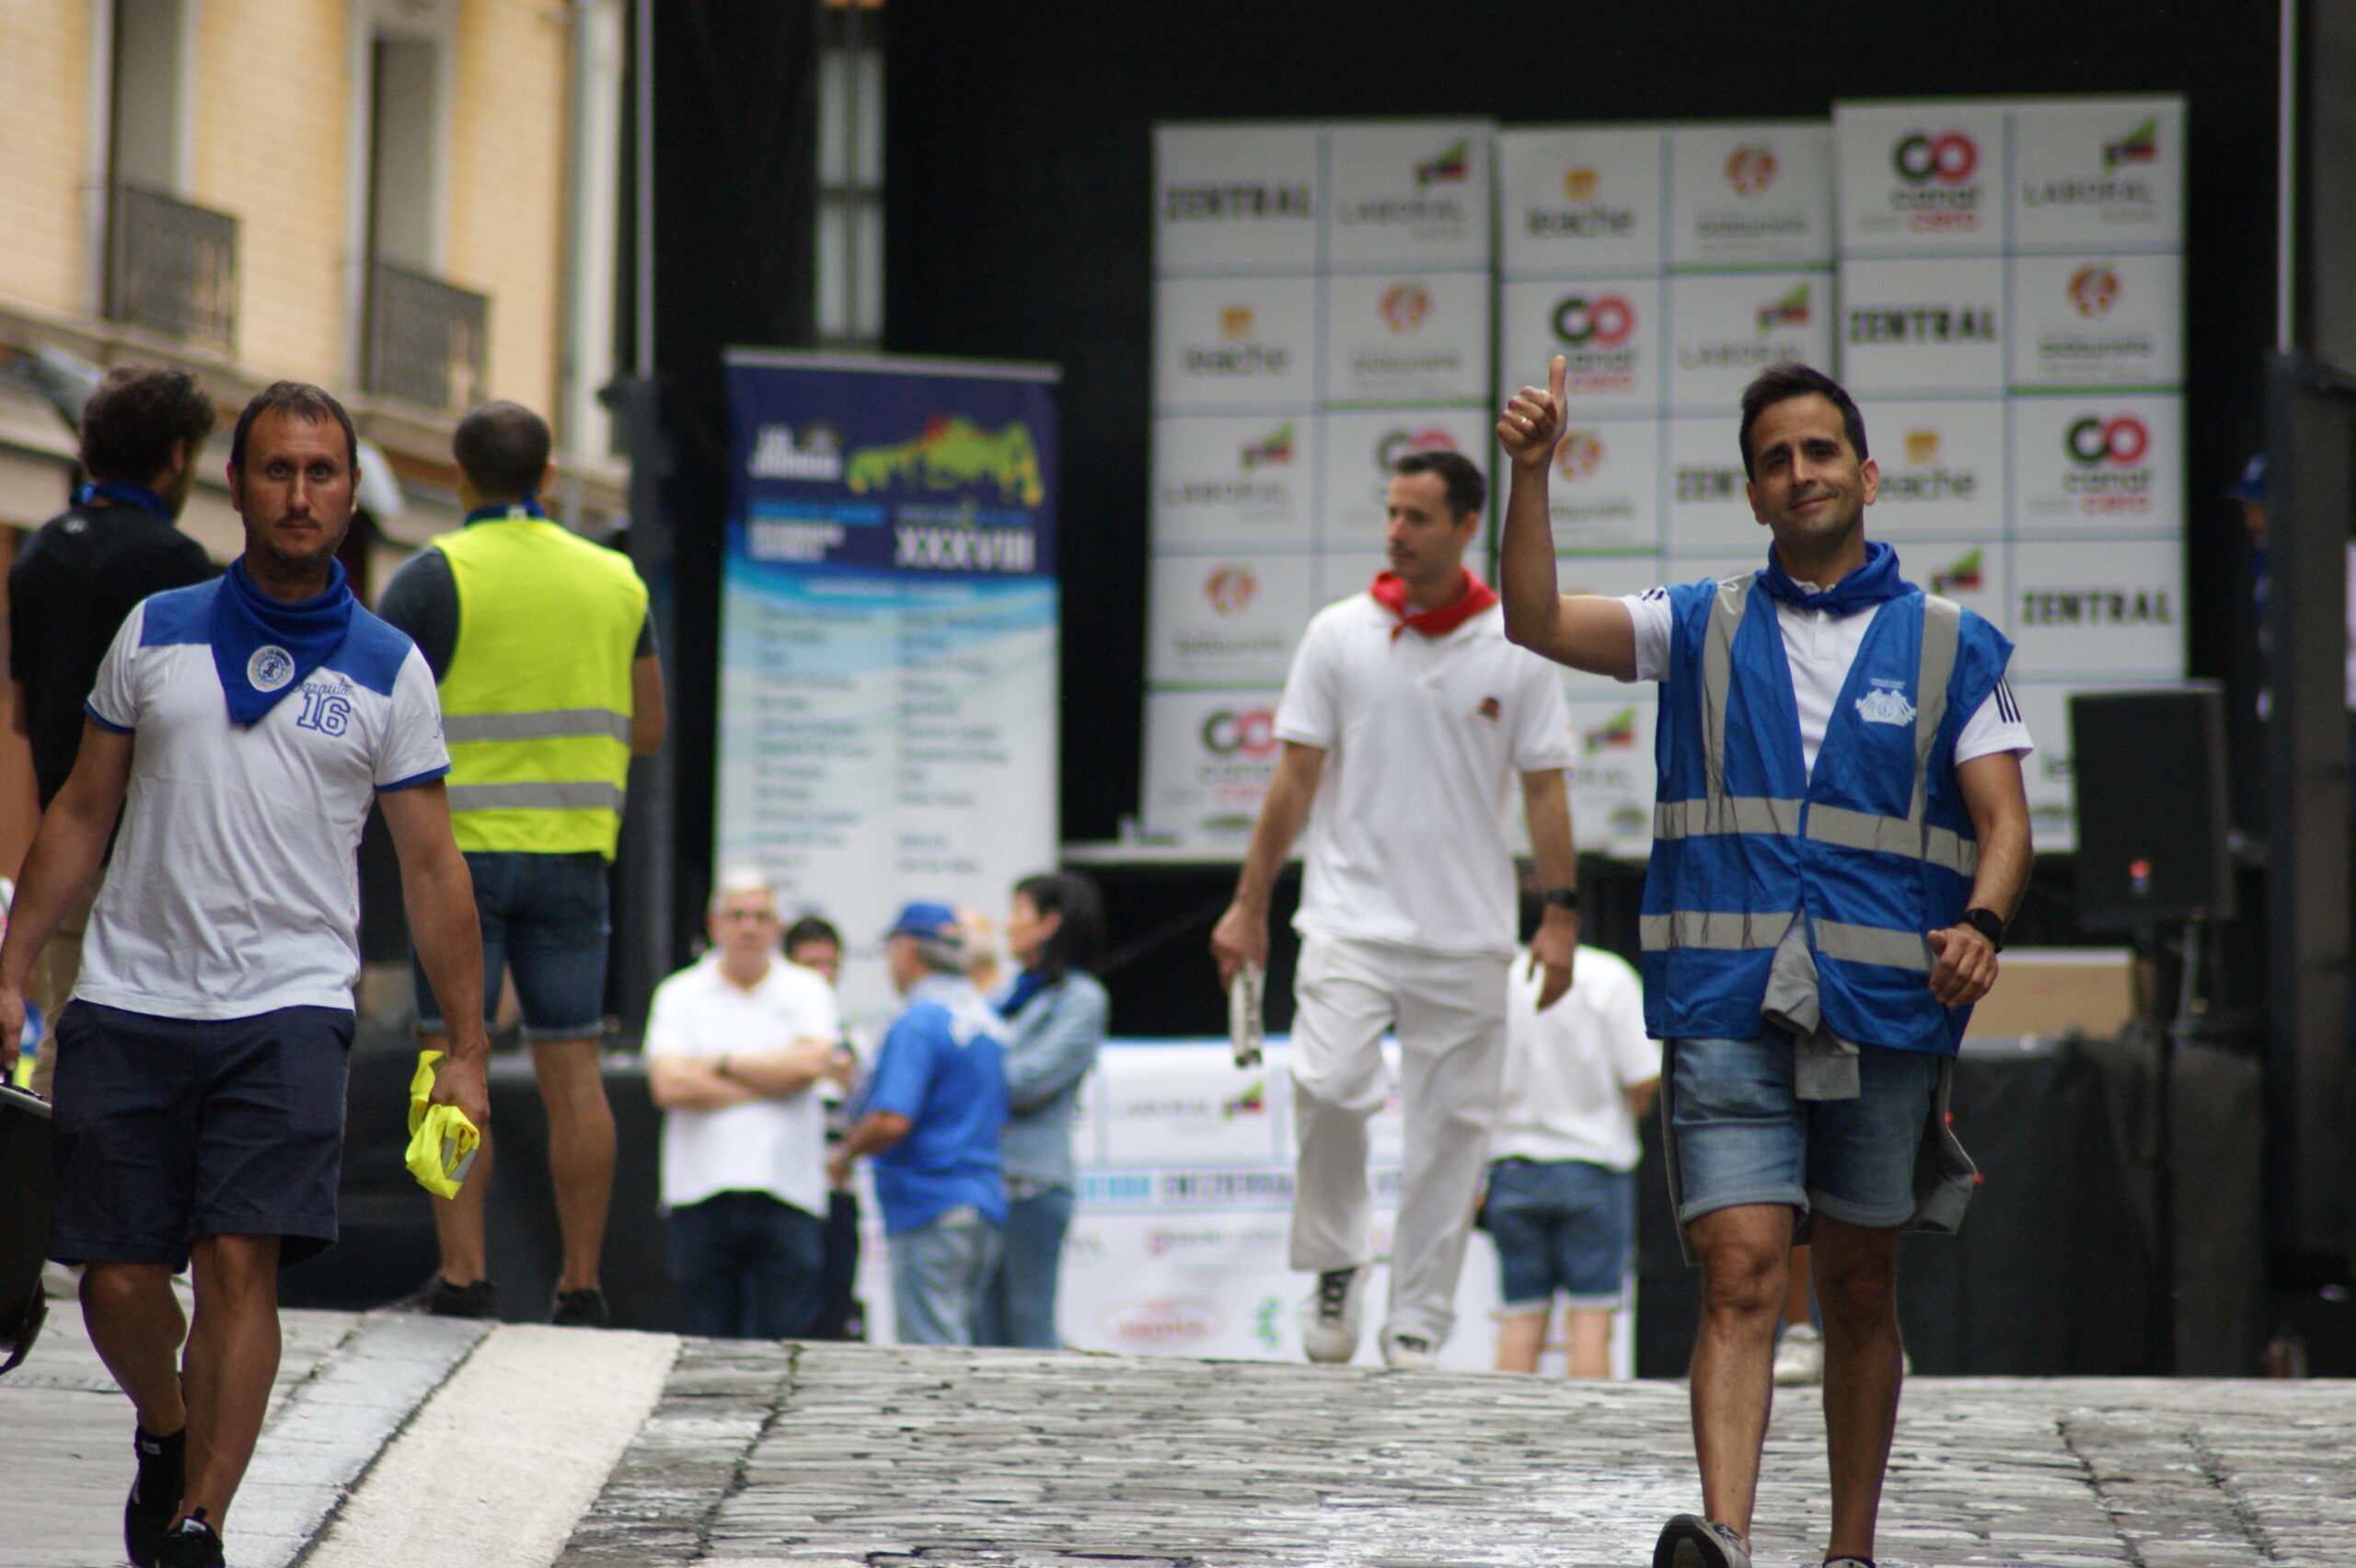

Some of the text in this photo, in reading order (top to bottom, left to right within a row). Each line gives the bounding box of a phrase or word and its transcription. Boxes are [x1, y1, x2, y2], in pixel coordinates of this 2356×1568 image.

[1165, 184, 1313, 221] ZENTRAL
[2025, 183, 2156, 207] LABORAL
[1848, 309, 1998, 345] ZENTRAL
[1877, 467, 1976, 501] eache
[2064, 469, 2149, 494] canal
[2021, 592, 2172, 625] ZENTRAL
[295, 691, 352, 738] 16
